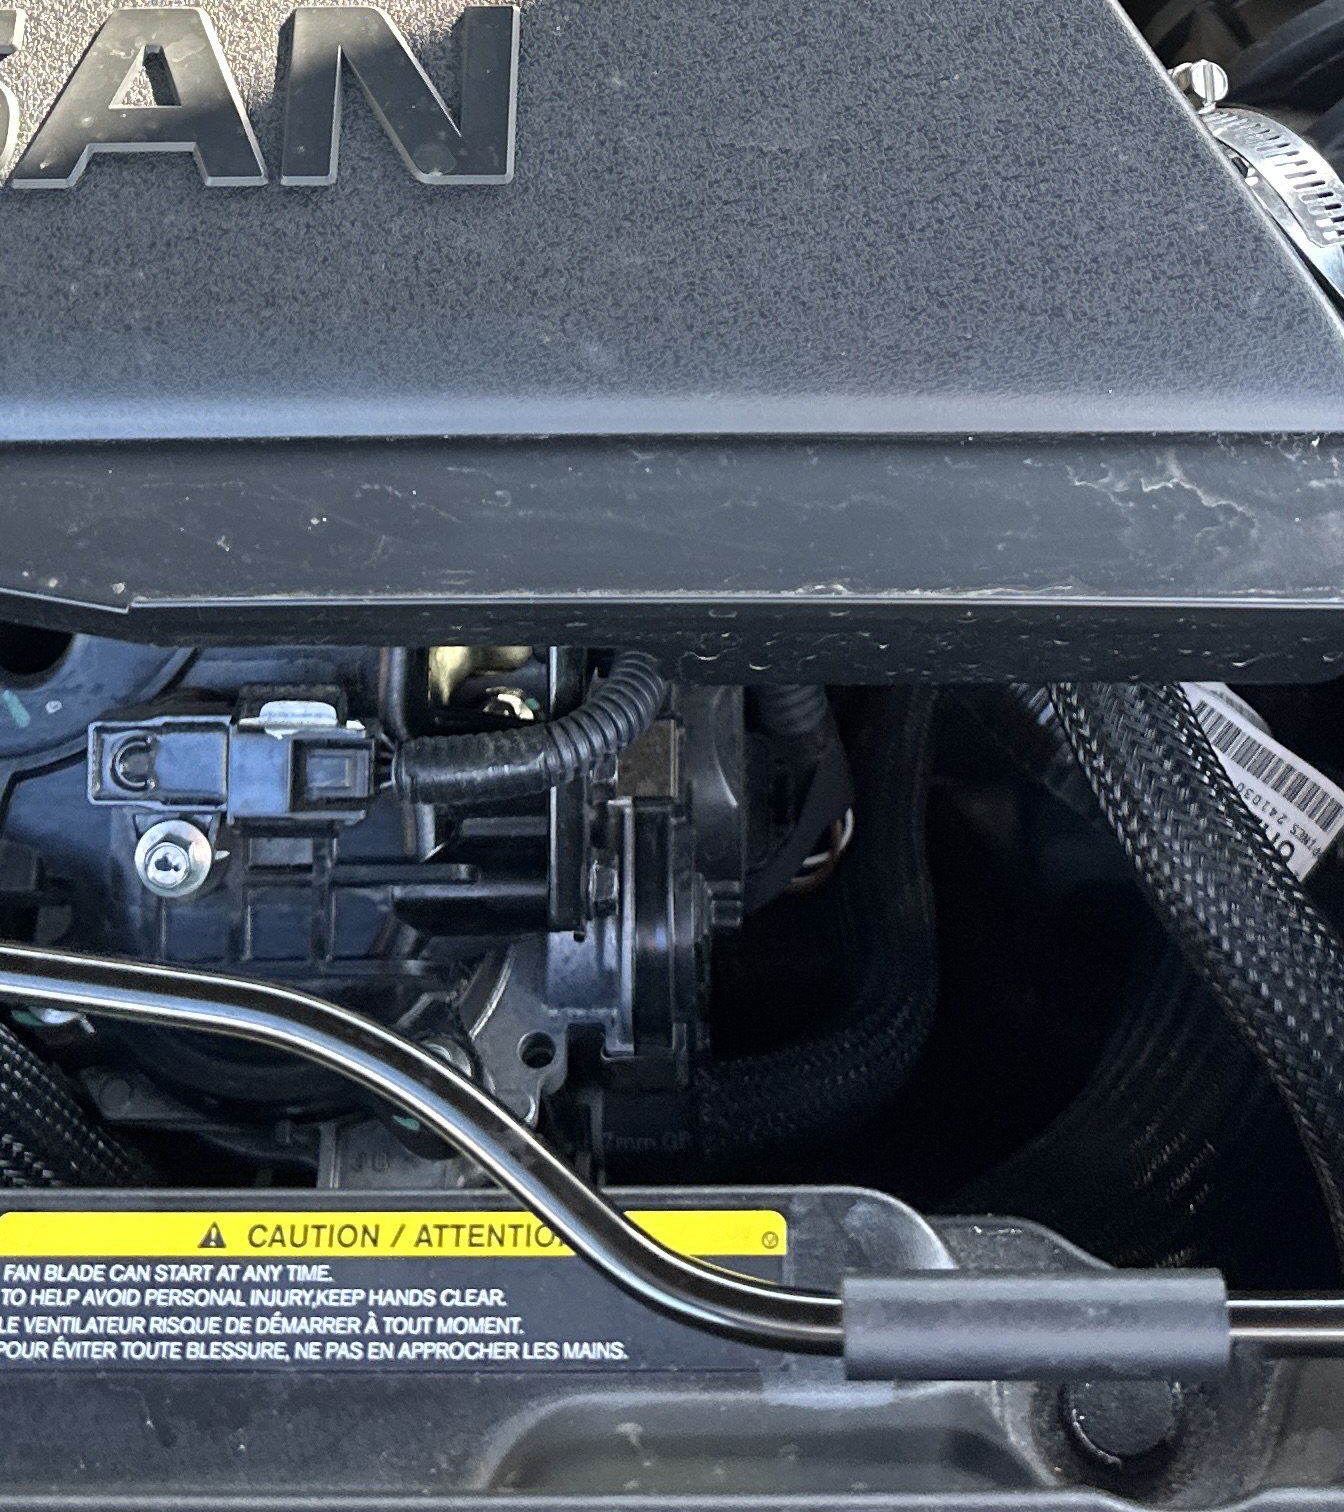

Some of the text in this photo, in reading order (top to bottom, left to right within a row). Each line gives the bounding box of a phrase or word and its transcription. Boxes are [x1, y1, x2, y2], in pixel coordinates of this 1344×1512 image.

[247, 1223, 566, 1249] CAUTION / ATTENTIO
[3, 1264, 334, 1282] FAN BLADE CAN START AT ANY TIME.
[1, 1288, 27, 1306] TO
[30, 1288, 80, 1306] HELP
[82, 1288, 141, 1306] AVOID
[144, 1288, 247, 1306] PERSONAL
[368, 1288, 437, 1306] HANDS
[439, 1288, 507, 1306] CLEAR.
[23, 1316, 146, 1335] VENTILATEUR
[149, 1316, 223, 1336] RISQUE
[225, 1316, 253, 1335] DE
[255, 1312, 362, 1335] DÉMARRER
[364, 1311, 379, 1335] À
[382, 1317, 434, 1335] TOUT
[436, 1317, 524, 1335] MOMENT.
[52, 1336, 118, 1360] ÉVITER
[121, 1341, 183, 1360] TOUTE
[186, 1341, 291, 1362] BLESSURE,
[293, 1342, 323, 1360] NE
[325, 1342, 364, 1360] PAS
[367, 1342, 394, 1360] EN
[397, 1342, 524, 1360] APPROCHER
[523, 1342, 560, 1360] LES
[562, 1342, 629, 1360] MAINS.
